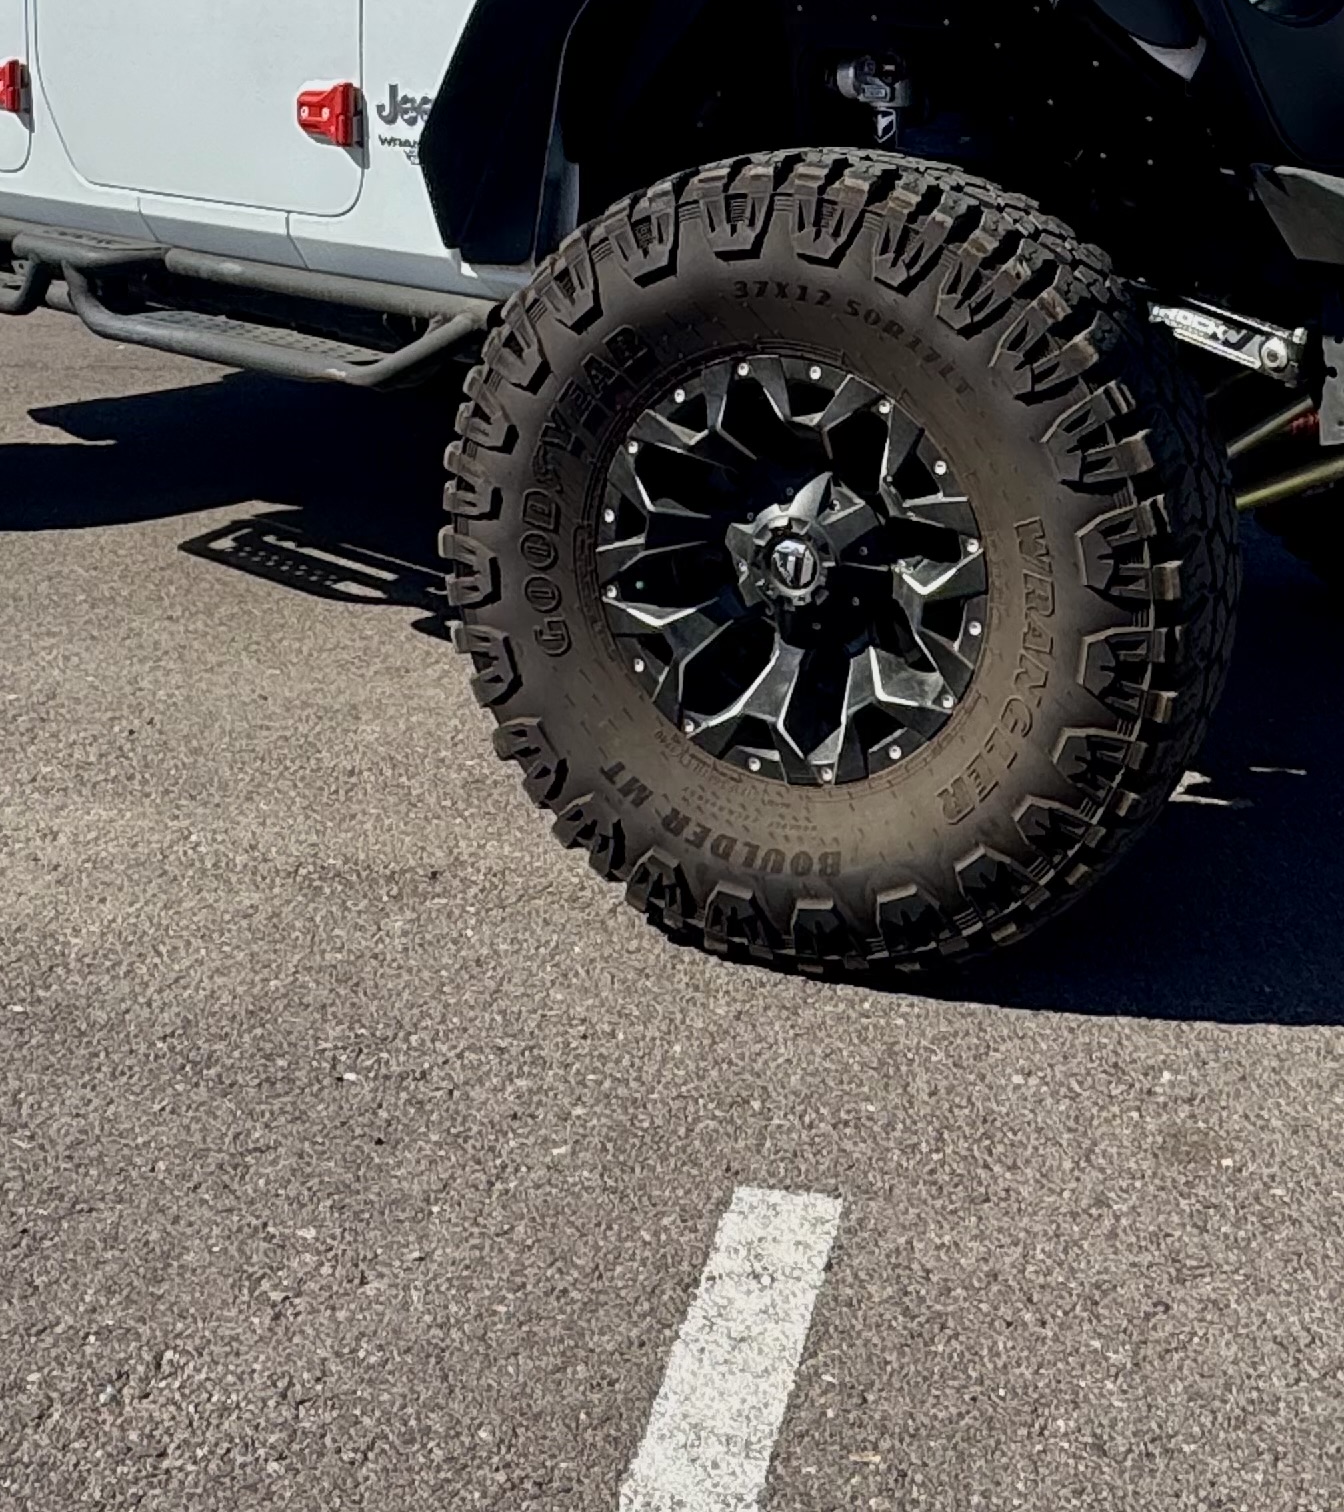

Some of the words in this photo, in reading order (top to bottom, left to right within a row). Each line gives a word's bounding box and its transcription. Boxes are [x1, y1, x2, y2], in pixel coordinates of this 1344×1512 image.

[376, 83, 434, 127] Jee
[520, 324, 648, 657] GOODYEAR
[935, 516, 1056, 826] WRANGLER
[599, 760, 654, 808] MT
[661, 806, 842, 878] BOULDER
